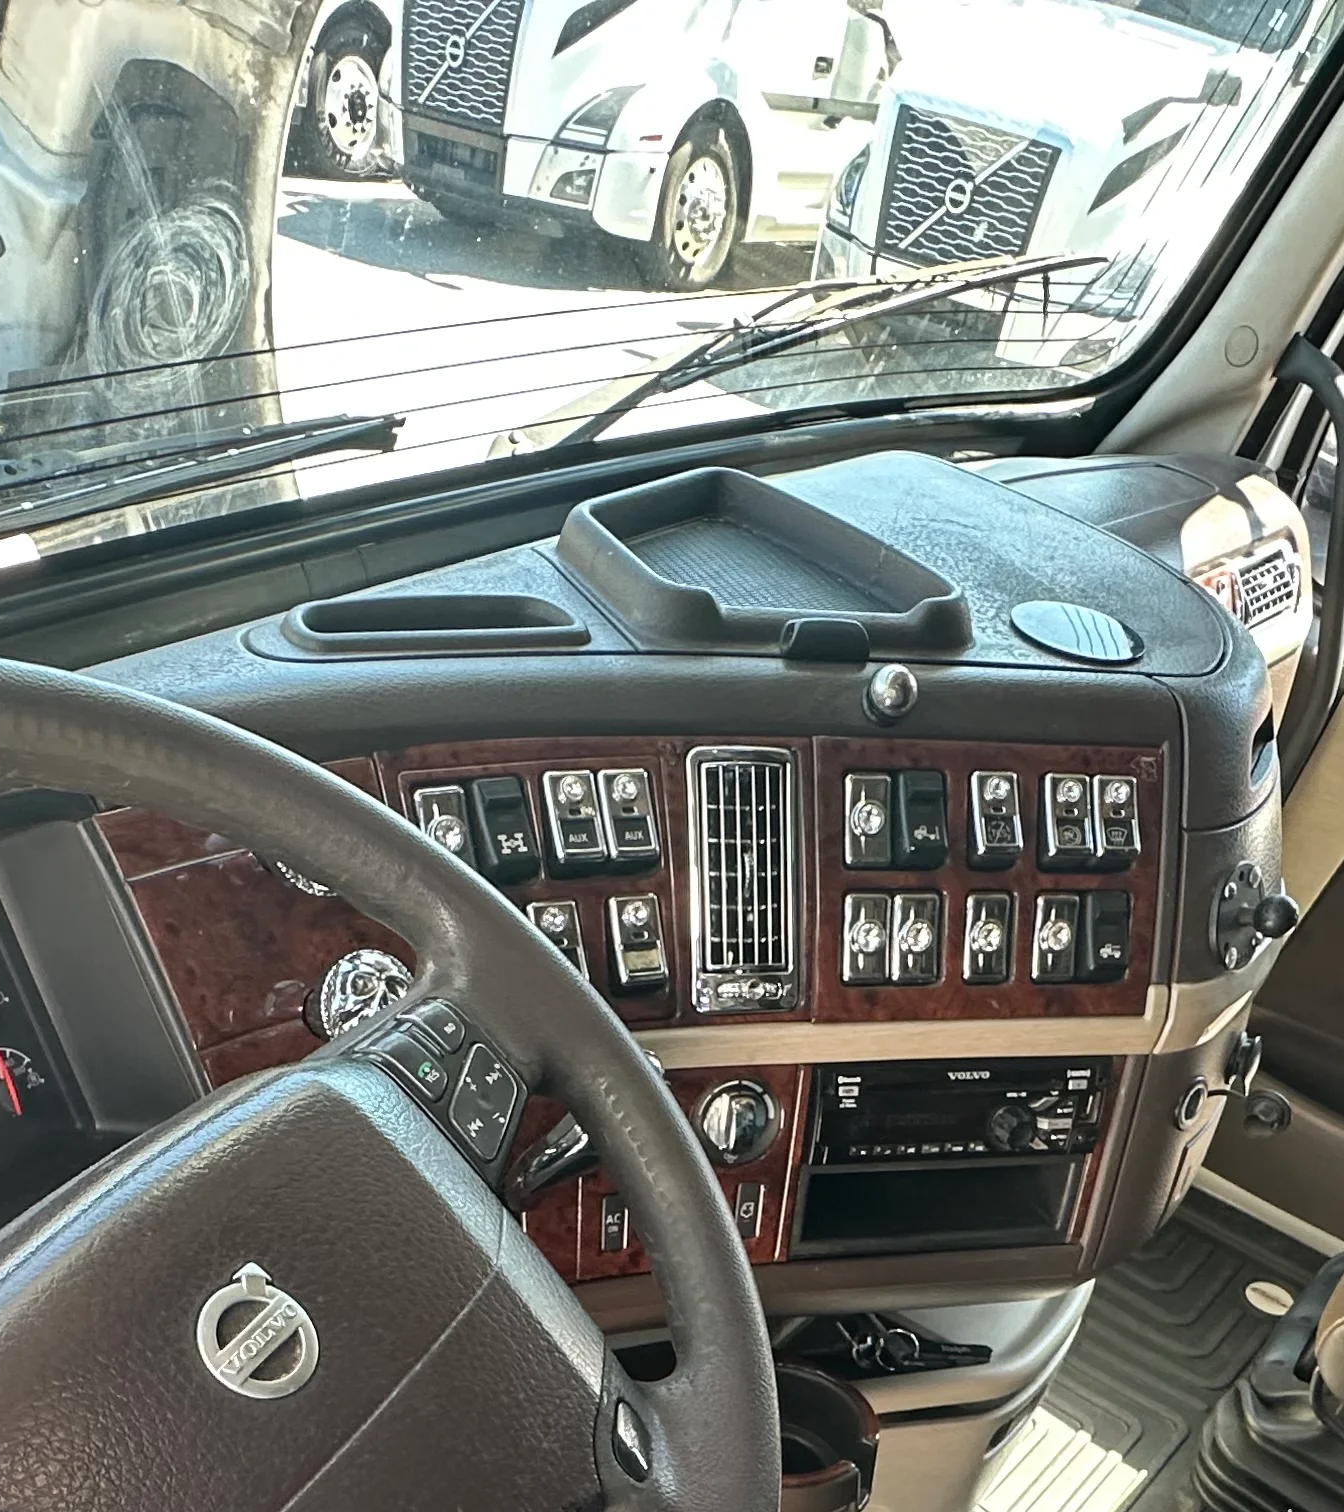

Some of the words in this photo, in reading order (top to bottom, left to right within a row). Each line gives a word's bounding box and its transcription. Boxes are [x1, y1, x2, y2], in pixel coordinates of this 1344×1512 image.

[568, 832, 589, 843] AUX
[625, 830, 644, 841] AUX
[947, 1070, 991, 1081] VOLVO
[606, 1213, 621, 1225] AC
[216, 1301, 298, 1374] VOLVO
